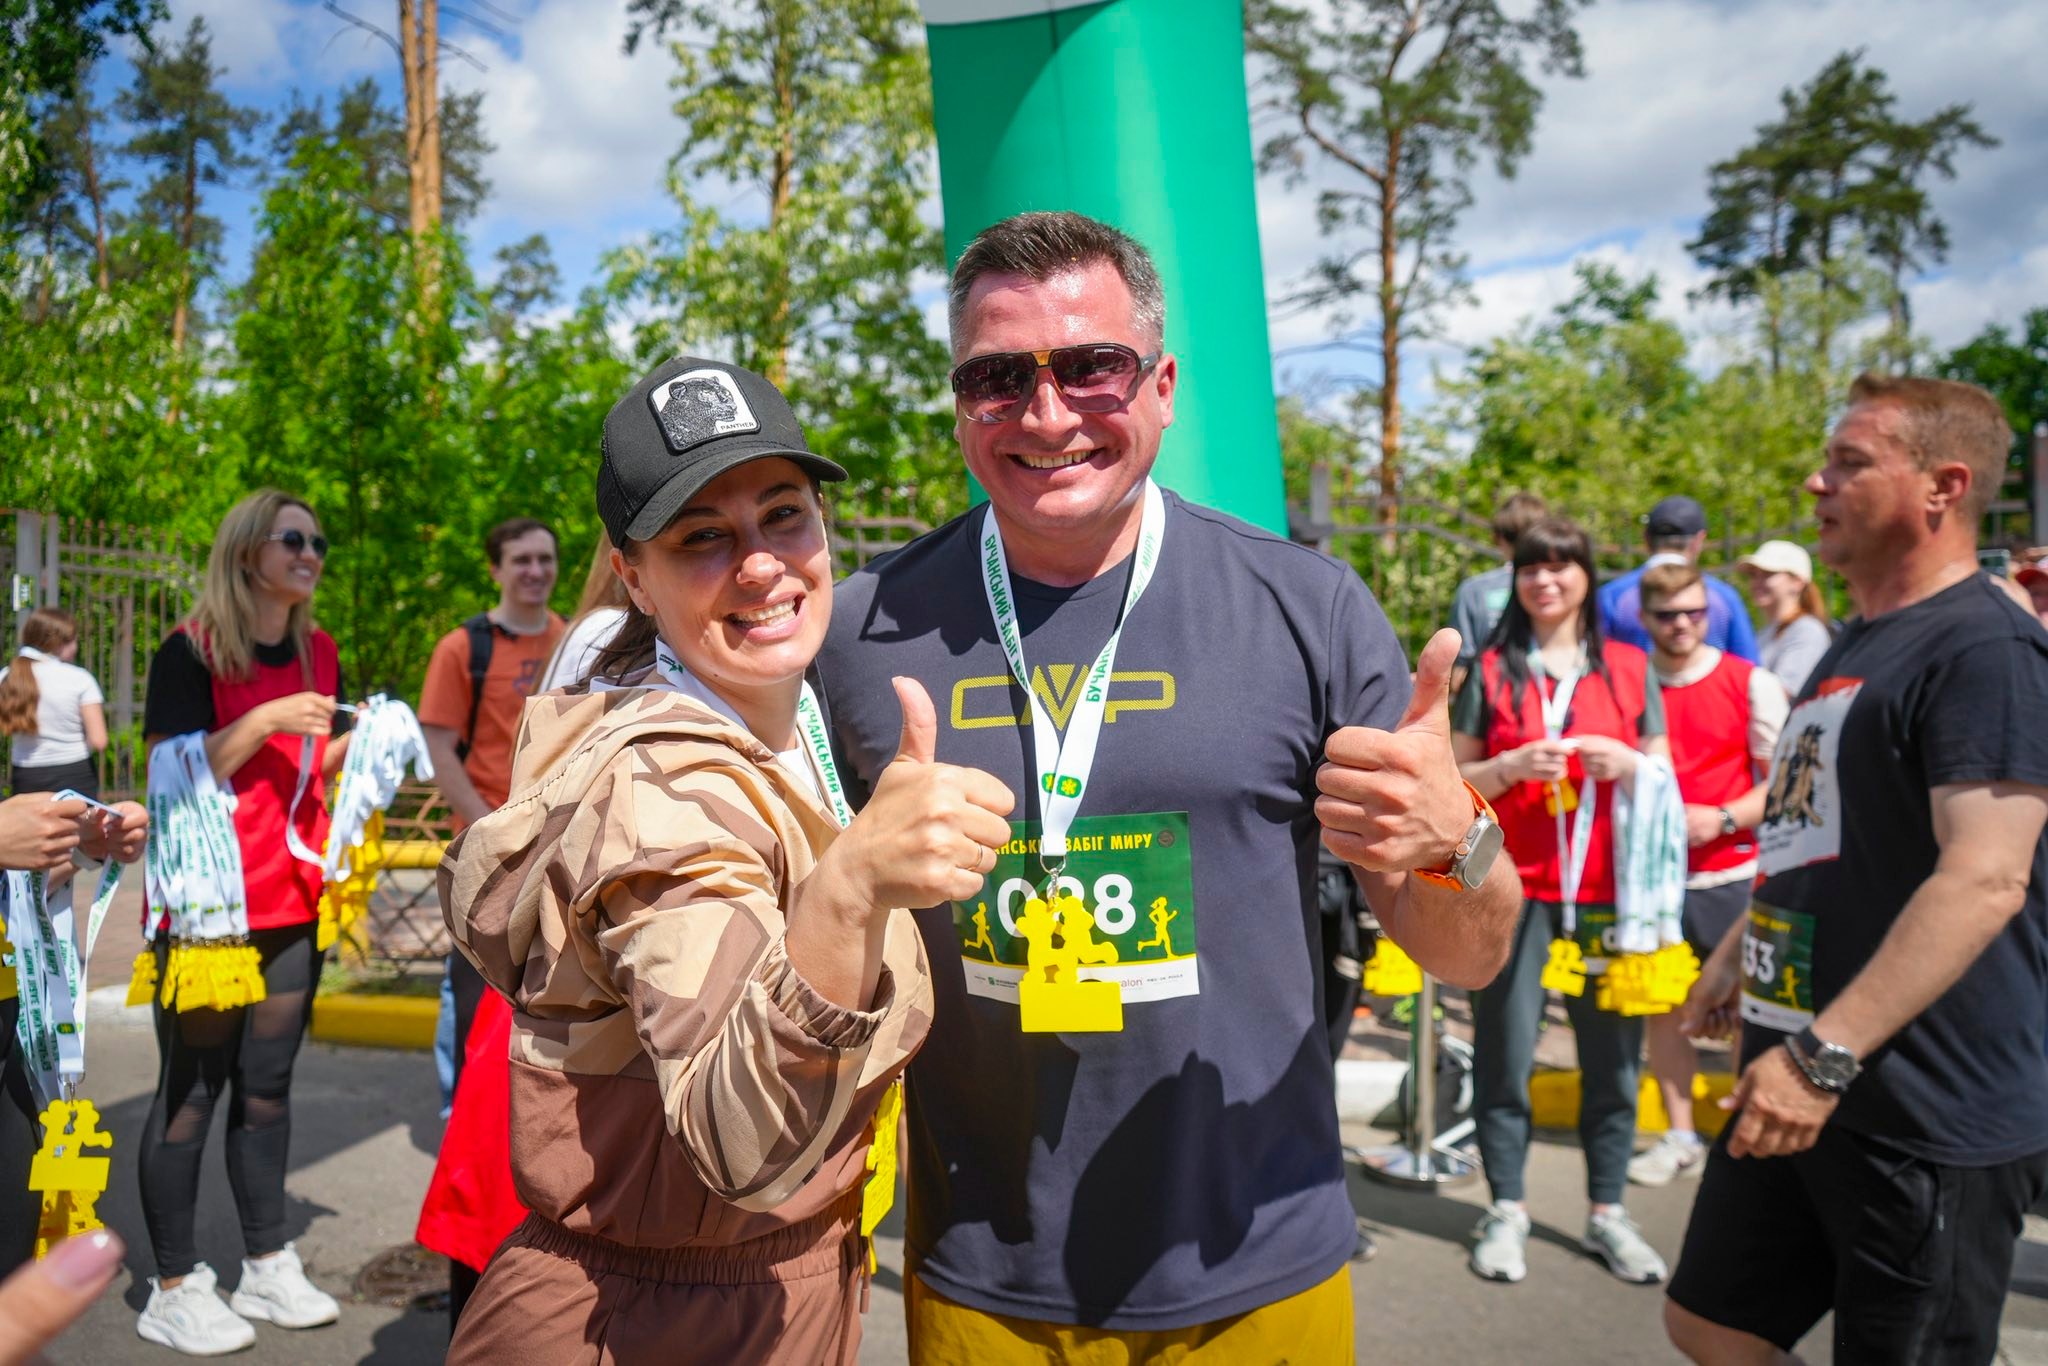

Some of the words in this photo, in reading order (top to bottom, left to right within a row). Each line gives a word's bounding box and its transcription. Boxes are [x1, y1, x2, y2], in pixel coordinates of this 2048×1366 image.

[720, 421, 755, 430] PANTHER
[984, 533, 1012, 620] БУЧАНСЬКИЙ
[1000, 618, 1018, 658] ЗАБІГ
[1013, 659, 1029, 689] МИ
[1085, 638, 1114, 702] БУЧАНС
[1110, 833, 1153, 850] МИРУ
